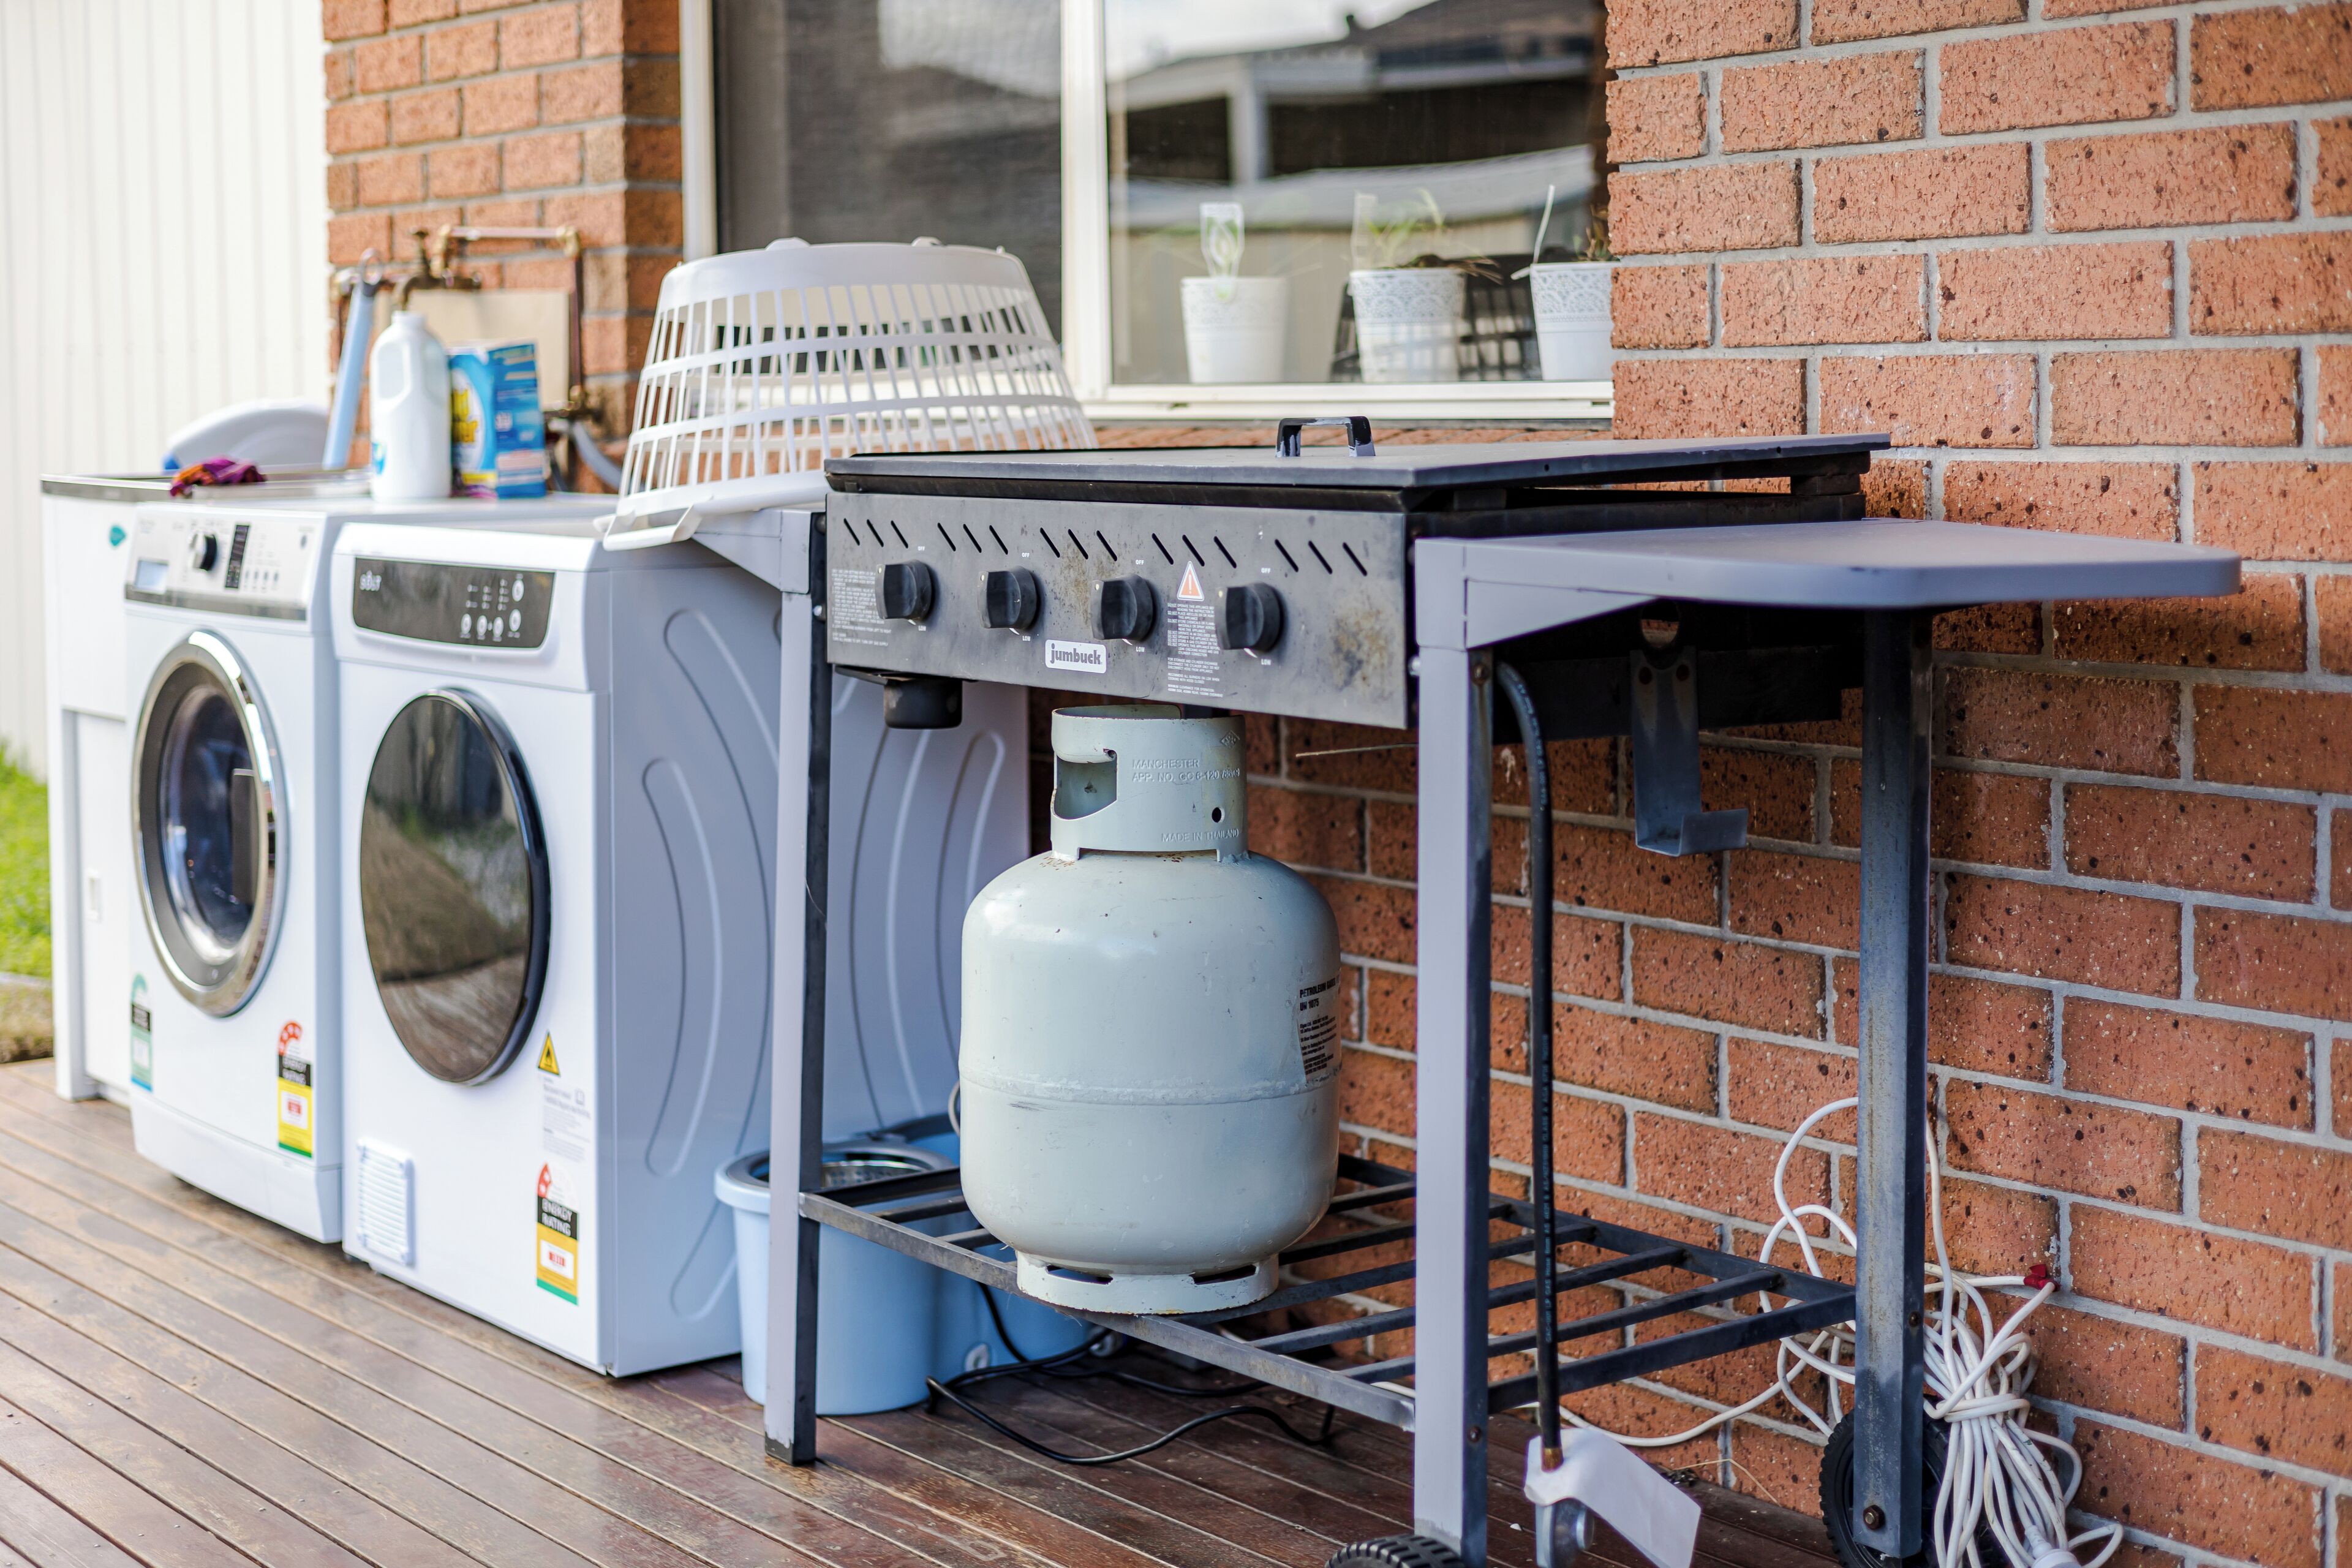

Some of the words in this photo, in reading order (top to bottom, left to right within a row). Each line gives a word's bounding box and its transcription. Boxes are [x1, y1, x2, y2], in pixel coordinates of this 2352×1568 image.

[1050, 643, 1101, 665] jumbuck
[1133, 759, 1200, 770] MANCHESTER
[1133, 772, 1155, 782] APP.
[1158, 772, 1176, 782] NO.
[1161, 832, 1190, 842] MADE
[1193, 832, 1202, 842] IN
[1206, 828, 1239, 840] THAILAND
[1300, 982, 1326, 998] PETROLEUM
[1300, 1001, 1307, 1011] UN
[1308, 998, 1319, 1009] 1075
